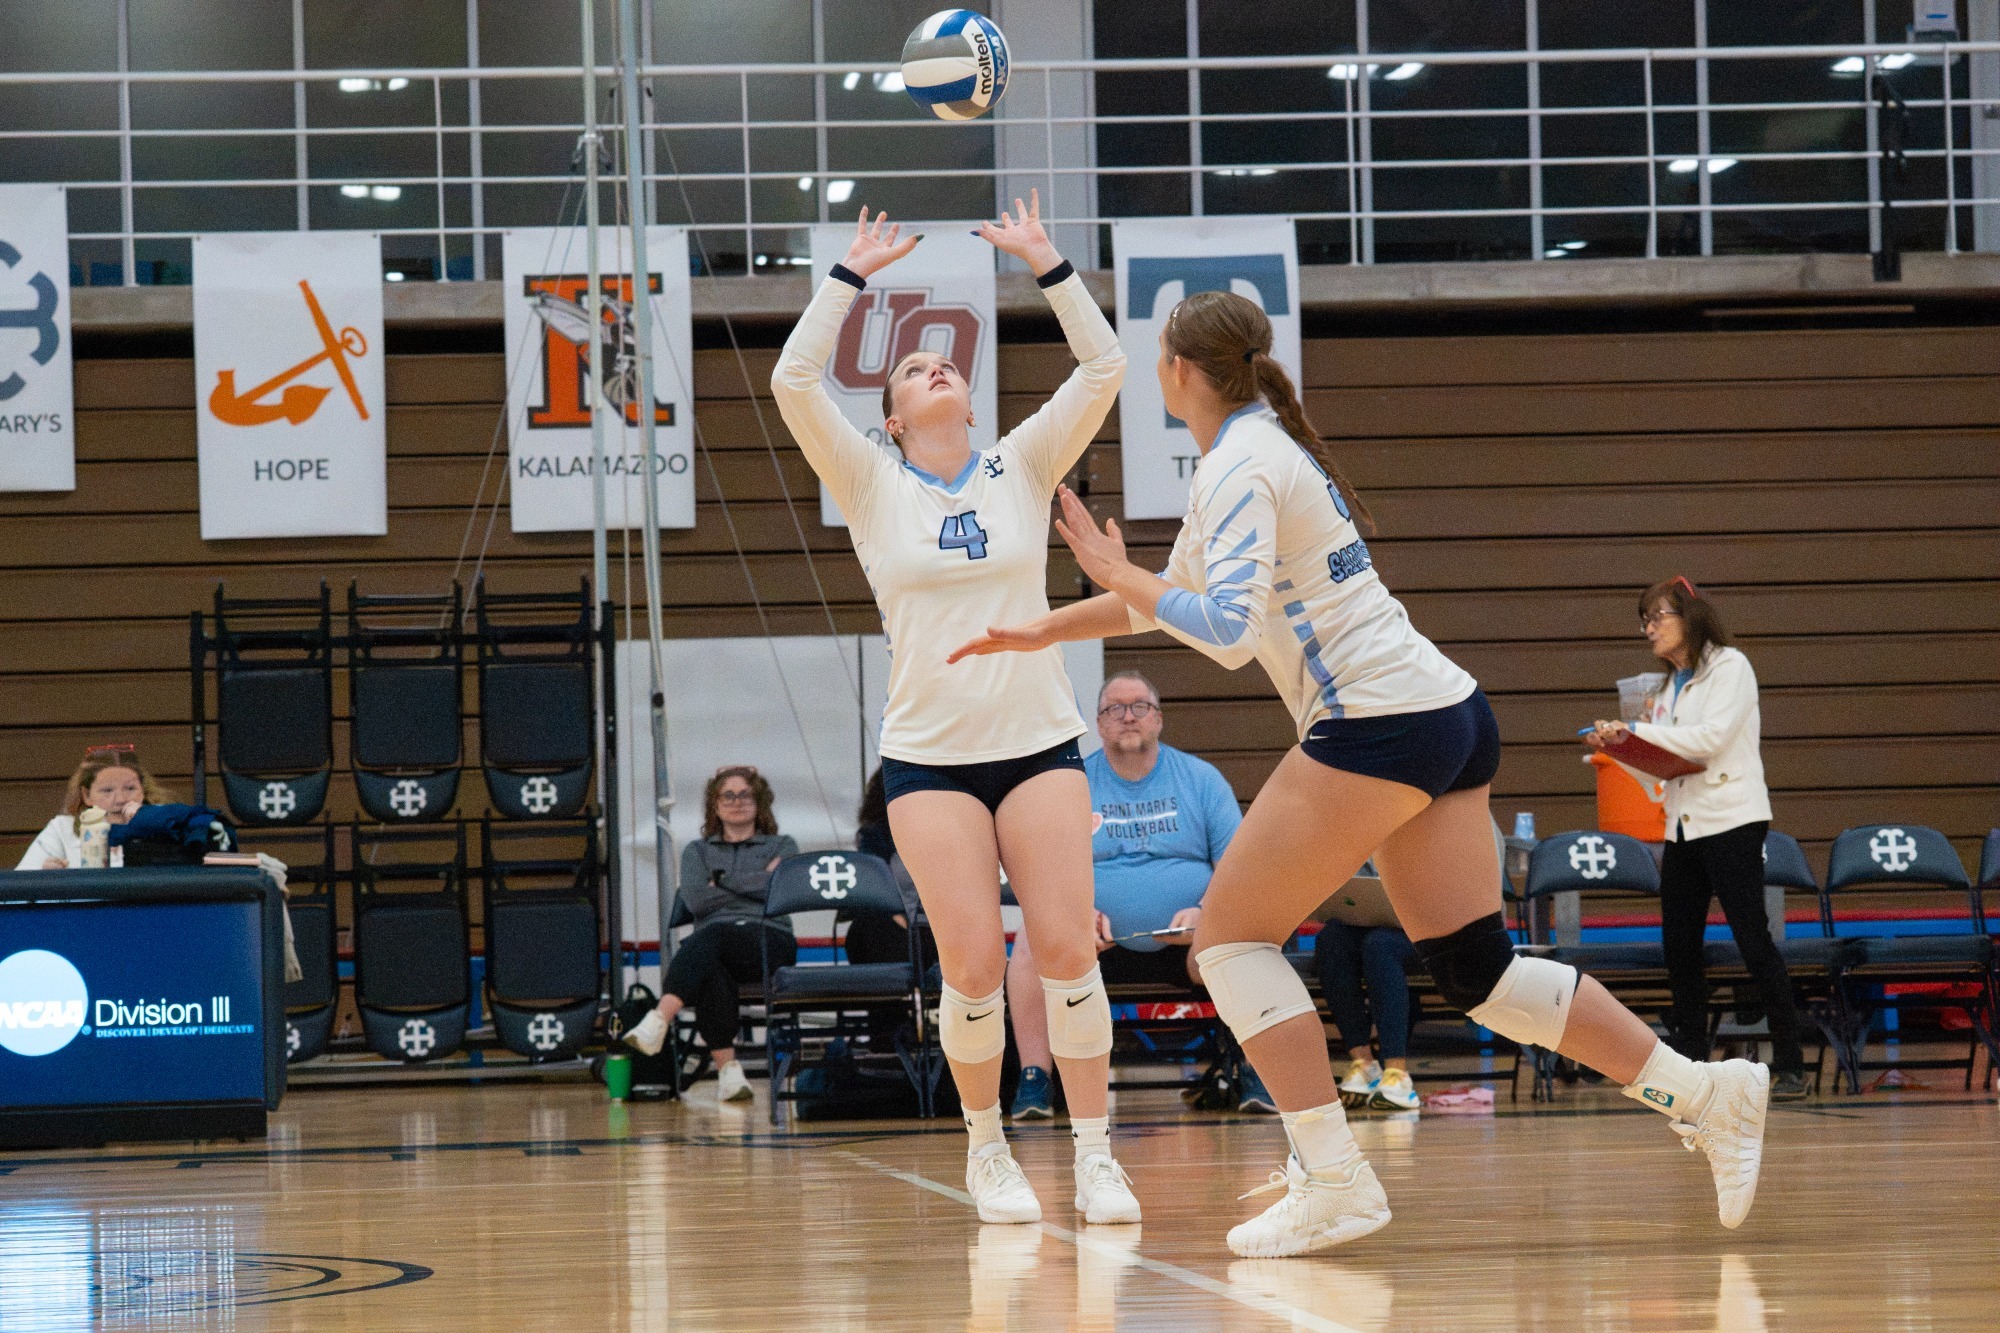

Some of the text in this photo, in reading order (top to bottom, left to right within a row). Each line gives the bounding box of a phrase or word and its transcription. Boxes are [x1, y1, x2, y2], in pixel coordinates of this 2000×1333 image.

[973, 33, 993, 95] molten
[0, 413, 62, 434] ARY'S
[254, 459, 330, 481] HOPE
[939, 510, 988, 560] 4
[1101, 797, 1178, 818] SAINT MARYS
[1106, 818, 1179, 839] VOLLEYBALL
[0, 1000, 84, 1030] NCAA
[95, 998, 203, 1027] Division
[96, 1024, 254, 1038] DISCOVER DEVELOP DEDICATE
